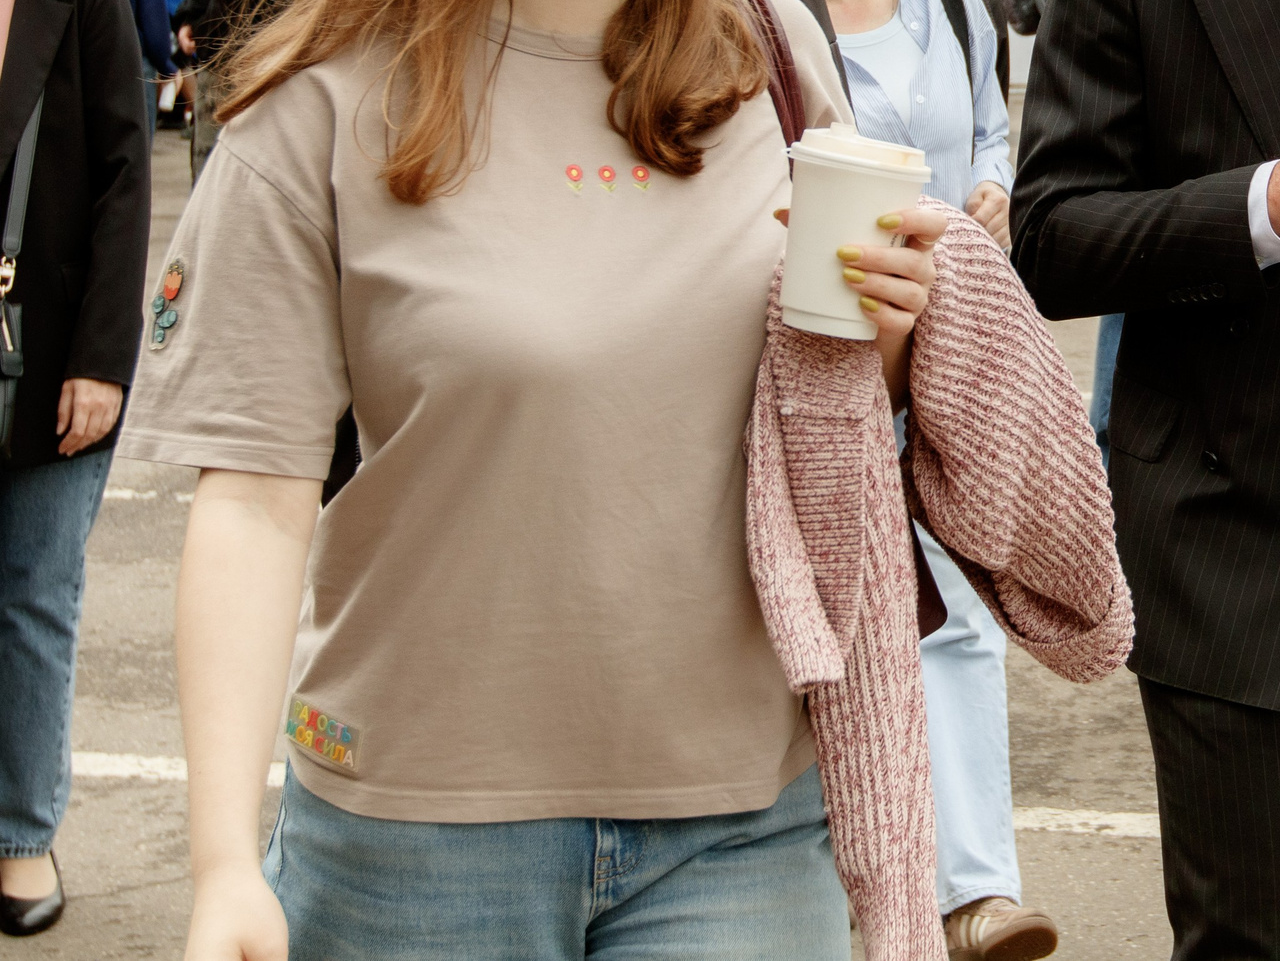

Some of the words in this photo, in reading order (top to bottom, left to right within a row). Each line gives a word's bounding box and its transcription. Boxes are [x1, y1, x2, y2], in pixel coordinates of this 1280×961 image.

[285, 718, 314, 747] МОЯ
[314, 736, 354, 767] СИЛА
[293, 700, 352, 743] РАДОСТЬ
